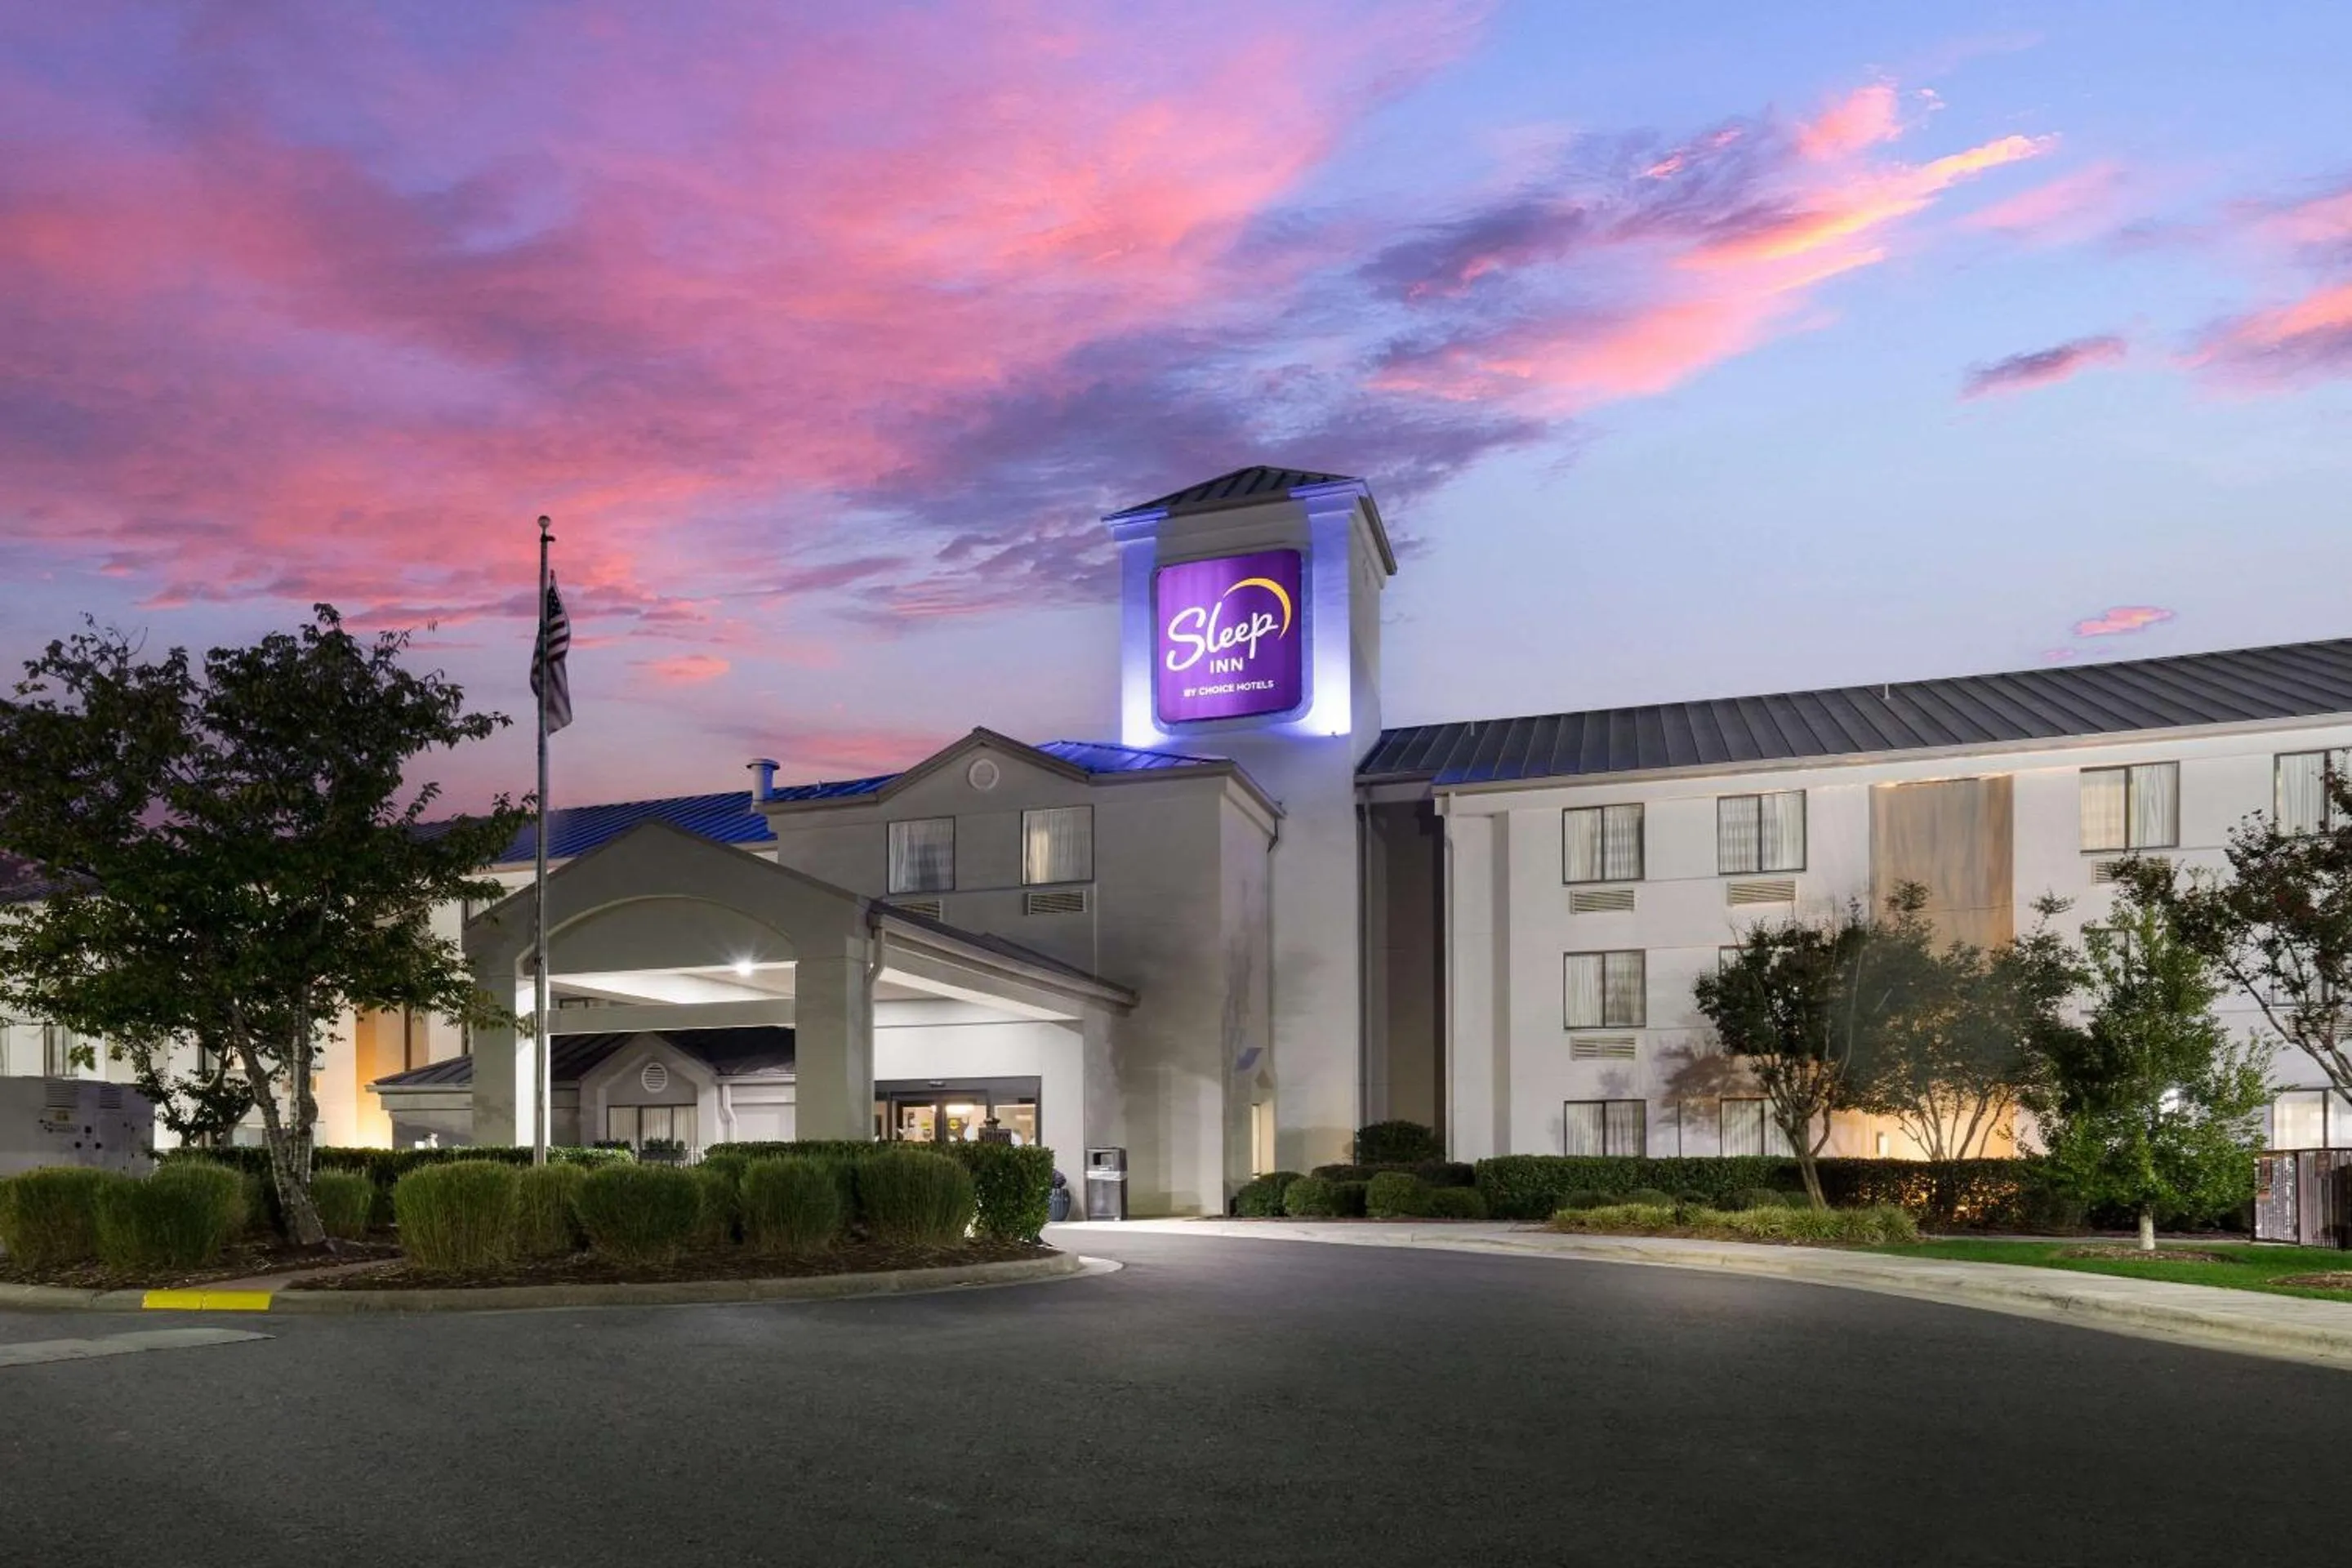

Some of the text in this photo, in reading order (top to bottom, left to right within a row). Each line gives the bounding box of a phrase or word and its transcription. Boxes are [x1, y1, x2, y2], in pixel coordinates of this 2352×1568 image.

[1166, 601, 1278, 670] Sleep
[1209, 657, 1244, 674] INN
[1183, 679, 1274, 697] BY CHOICE HOTELS
